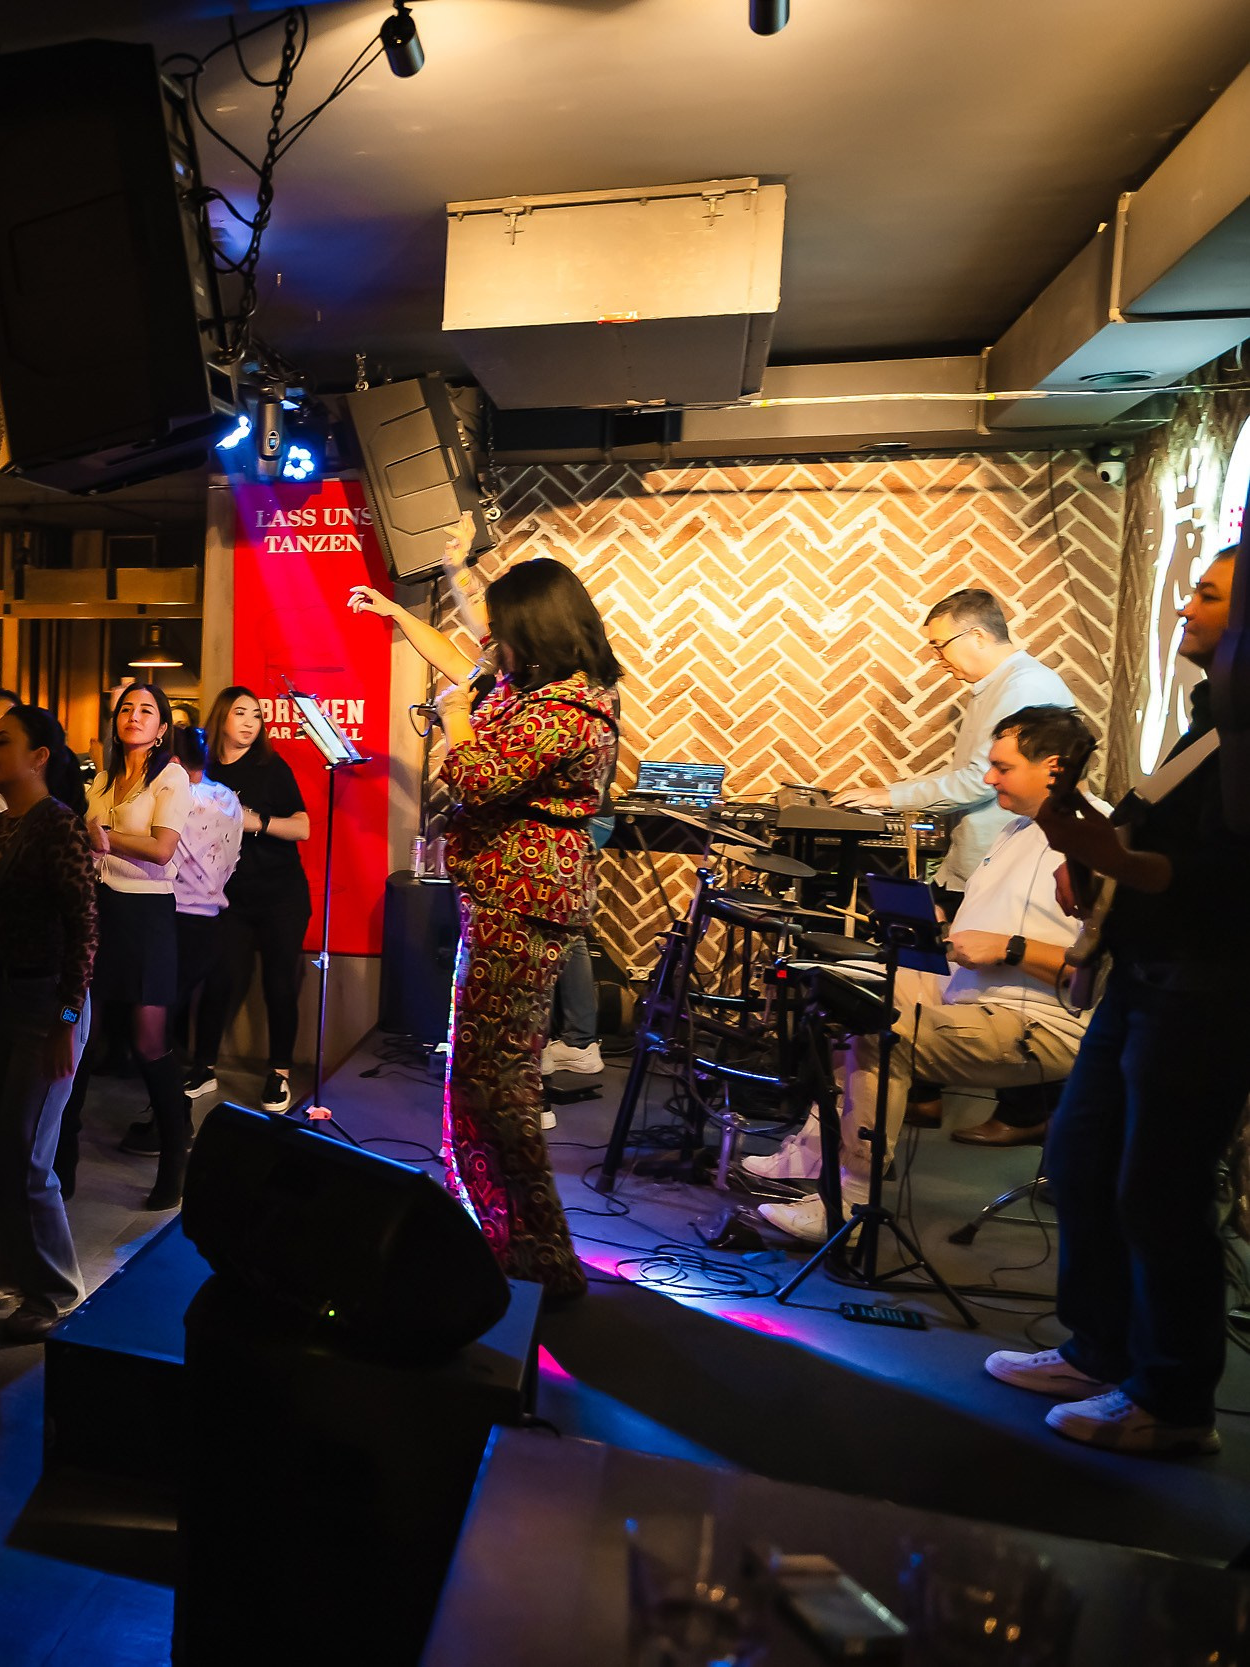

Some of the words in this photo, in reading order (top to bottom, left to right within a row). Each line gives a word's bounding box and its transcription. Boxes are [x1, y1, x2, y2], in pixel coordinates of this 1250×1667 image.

[255, 508, 317, 527] LASS
[323, 507, 374, 526] UNS
[264, 533, 365, 553] TANZEN
[265, 726, 292, 739] AR
